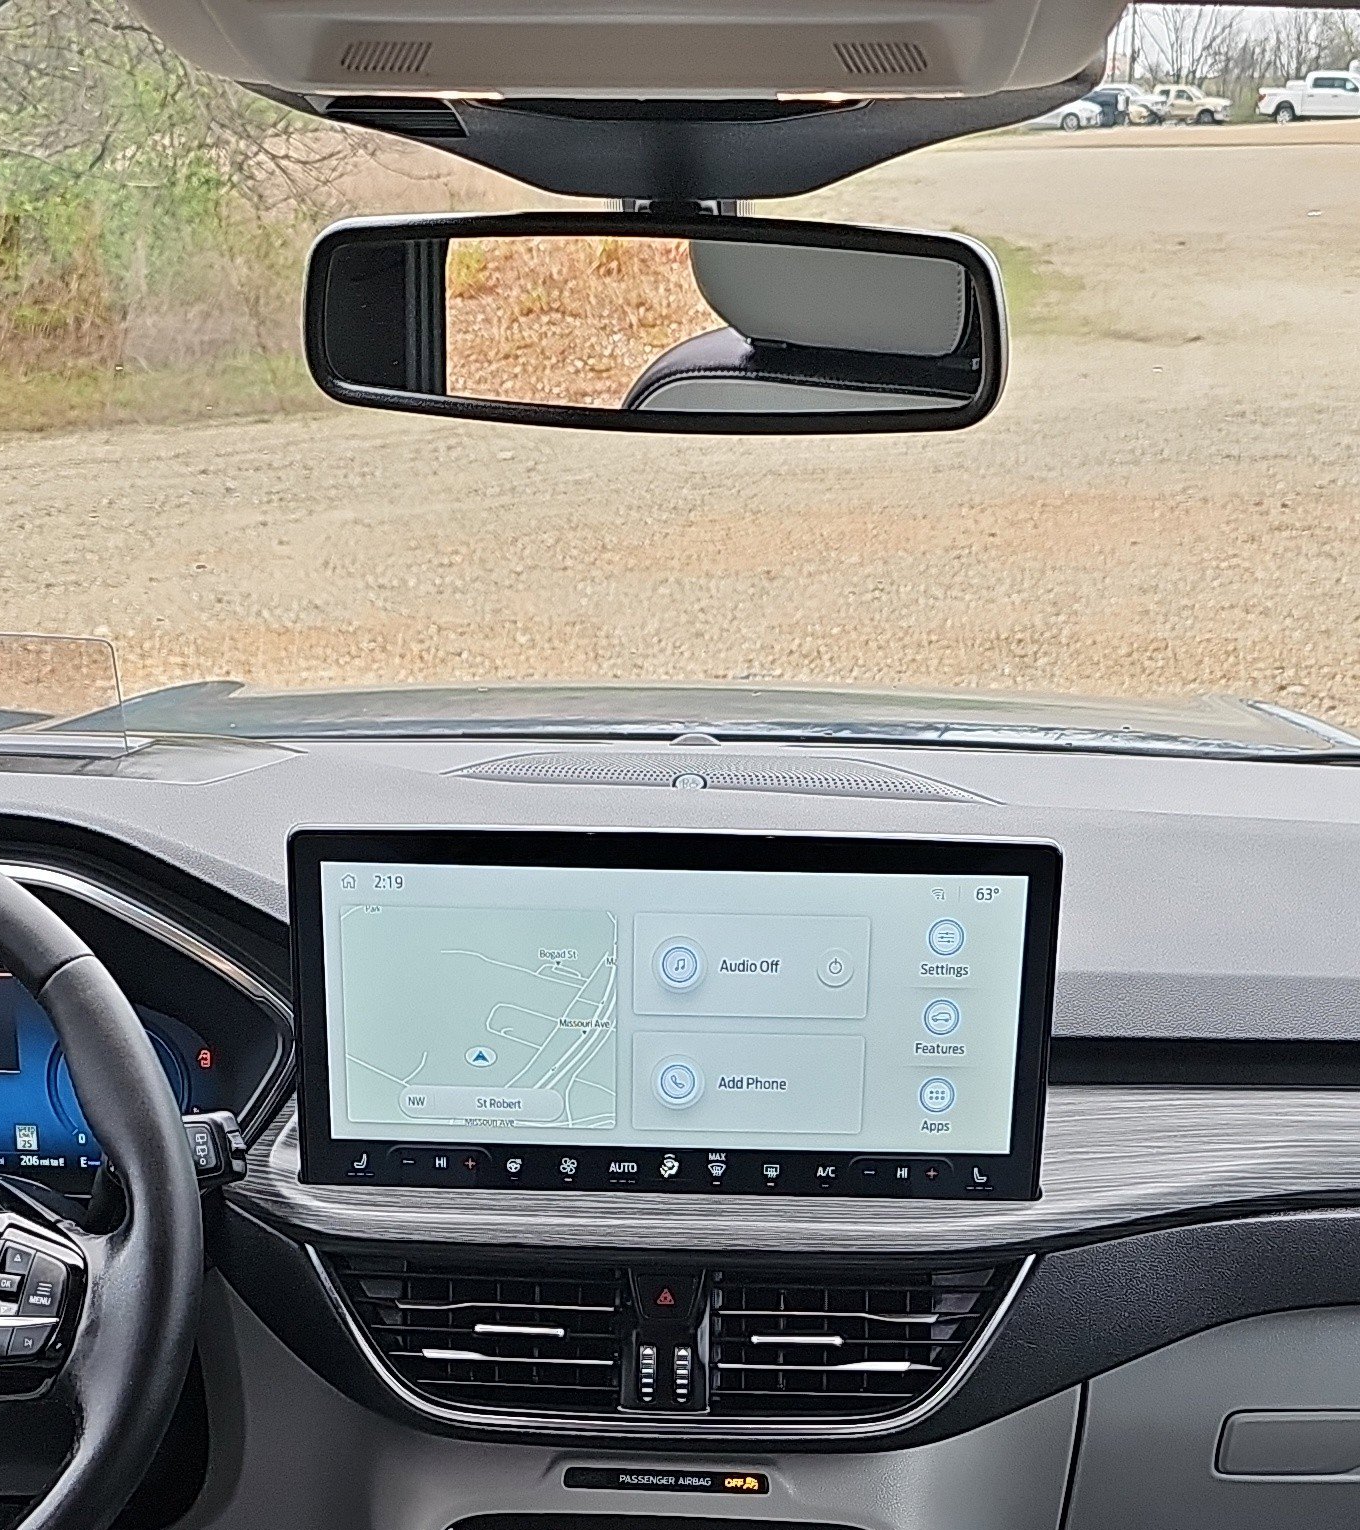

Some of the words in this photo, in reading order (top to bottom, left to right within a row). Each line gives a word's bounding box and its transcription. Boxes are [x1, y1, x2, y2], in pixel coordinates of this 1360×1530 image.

[374, 875, 403, 889] 2:19
[540, 950, 565, 960] Bogad
[568, 951, 577, 959] St
[720, 959, 757, 973] Audio
[760, 960, 780, 973] Off
[920, 963, 969, 977] Settings
[560, 1019, 592, 1028] Missouri
[595, 1020, 610, 1028] Ave
[915, 1042, 965, 1055] Features
[718, 1076, 743, 1090] Add
[747, 1077, 787, 1091] Phone
[408, 1096, 425, 1107] NW
[477, 1099, 487, 1109] St
[490, 1099, 521, 1110] Robert
[921, 1121, 950, 1133] Apps
[22, 1140, 32, 1148] 25
[20, 1155, 39, 1166] 206
[435, 1157, 447, 1168] HI
[709, 1153, 726, 1161] MAX
[609, 1161, 637, 1173] AUTO
[817, 1166, 836, 1177] A/C
[897, 1167, 908, 1179] HI
[0, 1280, 11, 1288] OK
[28, 1295, 51, 1306] MENU
[619, 1474, 676, 1485] PASSENGER
[677, 1476, 712, 1486] AIRBAG
[724, 1477, 744, 1488] OFF
